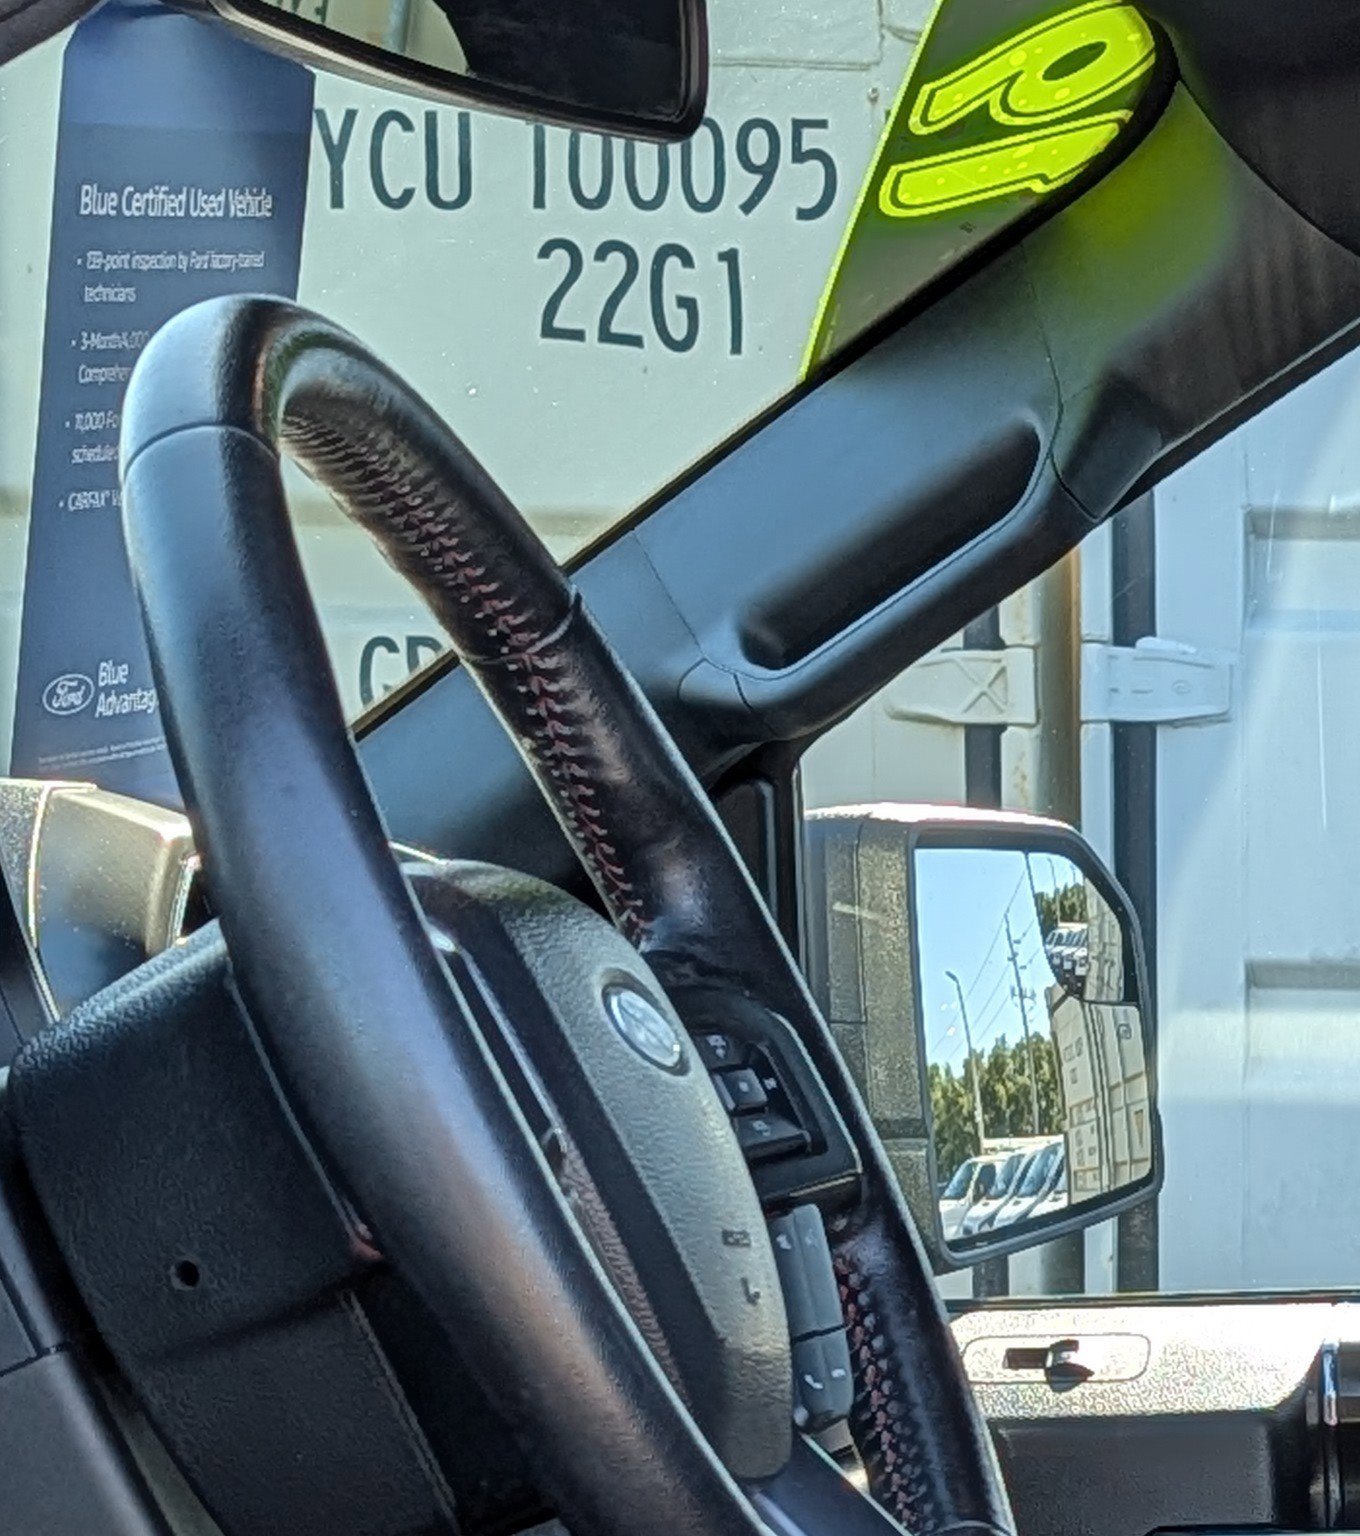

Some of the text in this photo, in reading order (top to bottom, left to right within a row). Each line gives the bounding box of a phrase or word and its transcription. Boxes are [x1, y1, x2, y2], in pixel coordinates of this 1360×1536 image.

[79, 184, 273, 219] Blue Certified Used Vehicle
[536, 237, 744, 356] 22G1
[98, 660, 129, 687] Blue
[48, 677, 90, 711] Ford
[95, 687, 159, 718] Advantag
